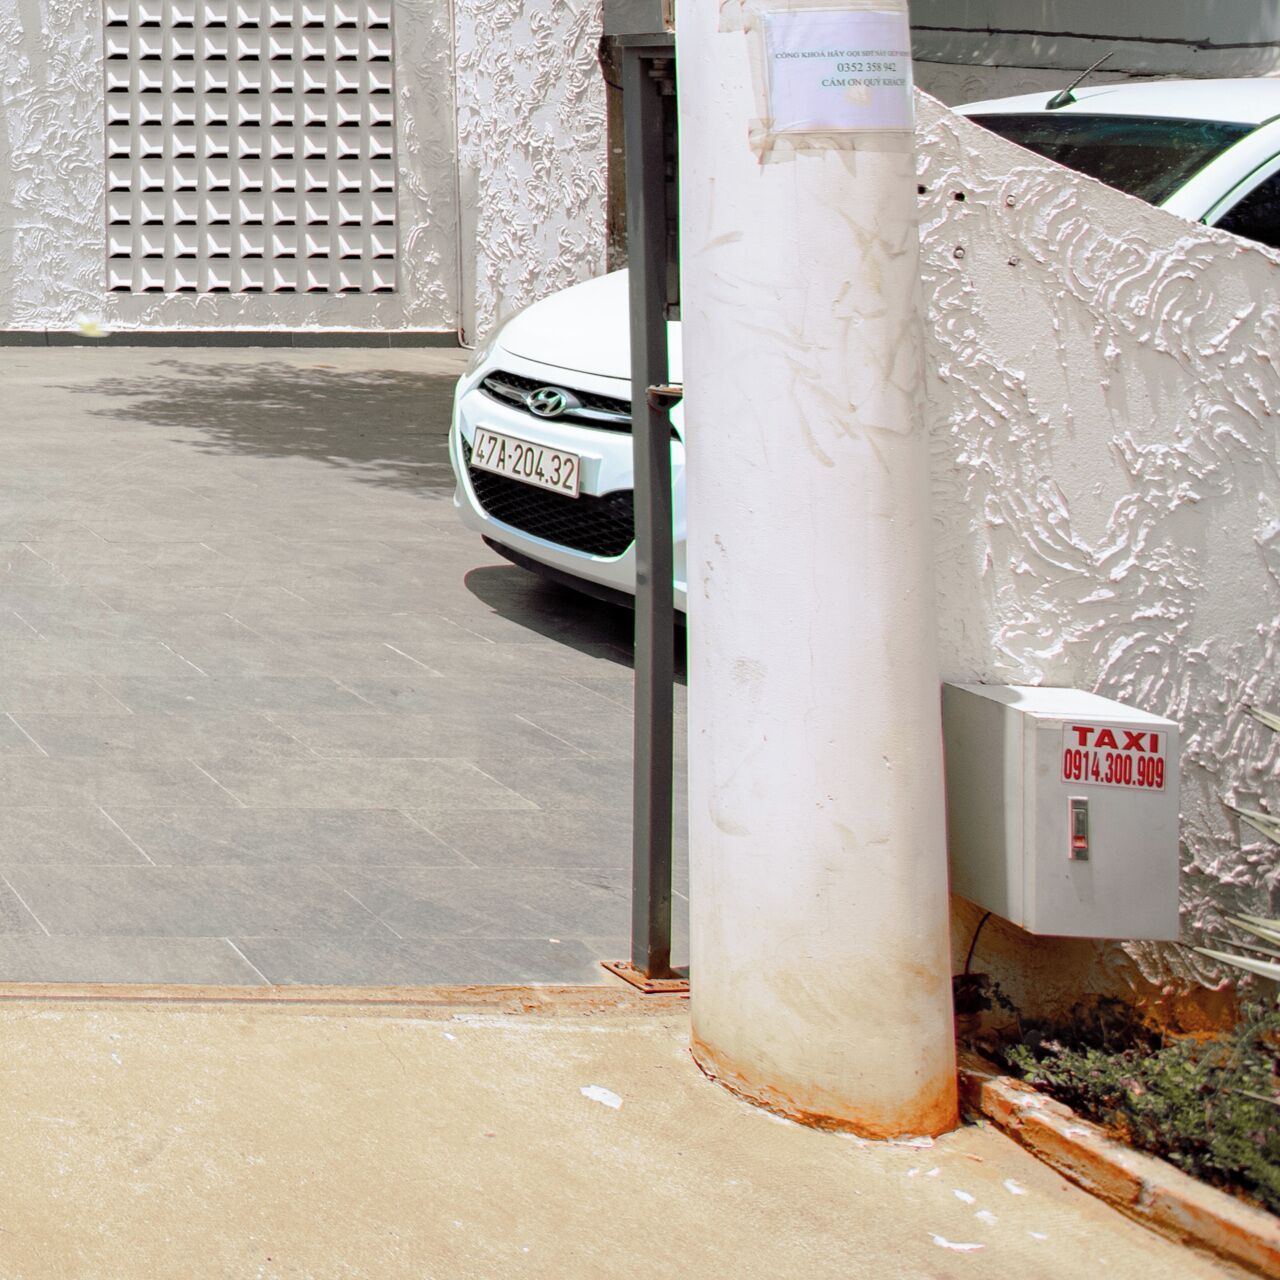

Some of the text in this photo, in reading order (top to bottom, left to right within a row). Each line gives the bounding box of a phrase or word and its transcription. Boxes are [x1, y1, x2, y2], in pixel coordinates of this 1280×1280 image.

[837, 62, 863, 72] 0352
[866, 62, 882, 72] 358
[1072, 726, 1159, 753] TAXI
[1064, 748, 1164, 789] 0914.300.909
